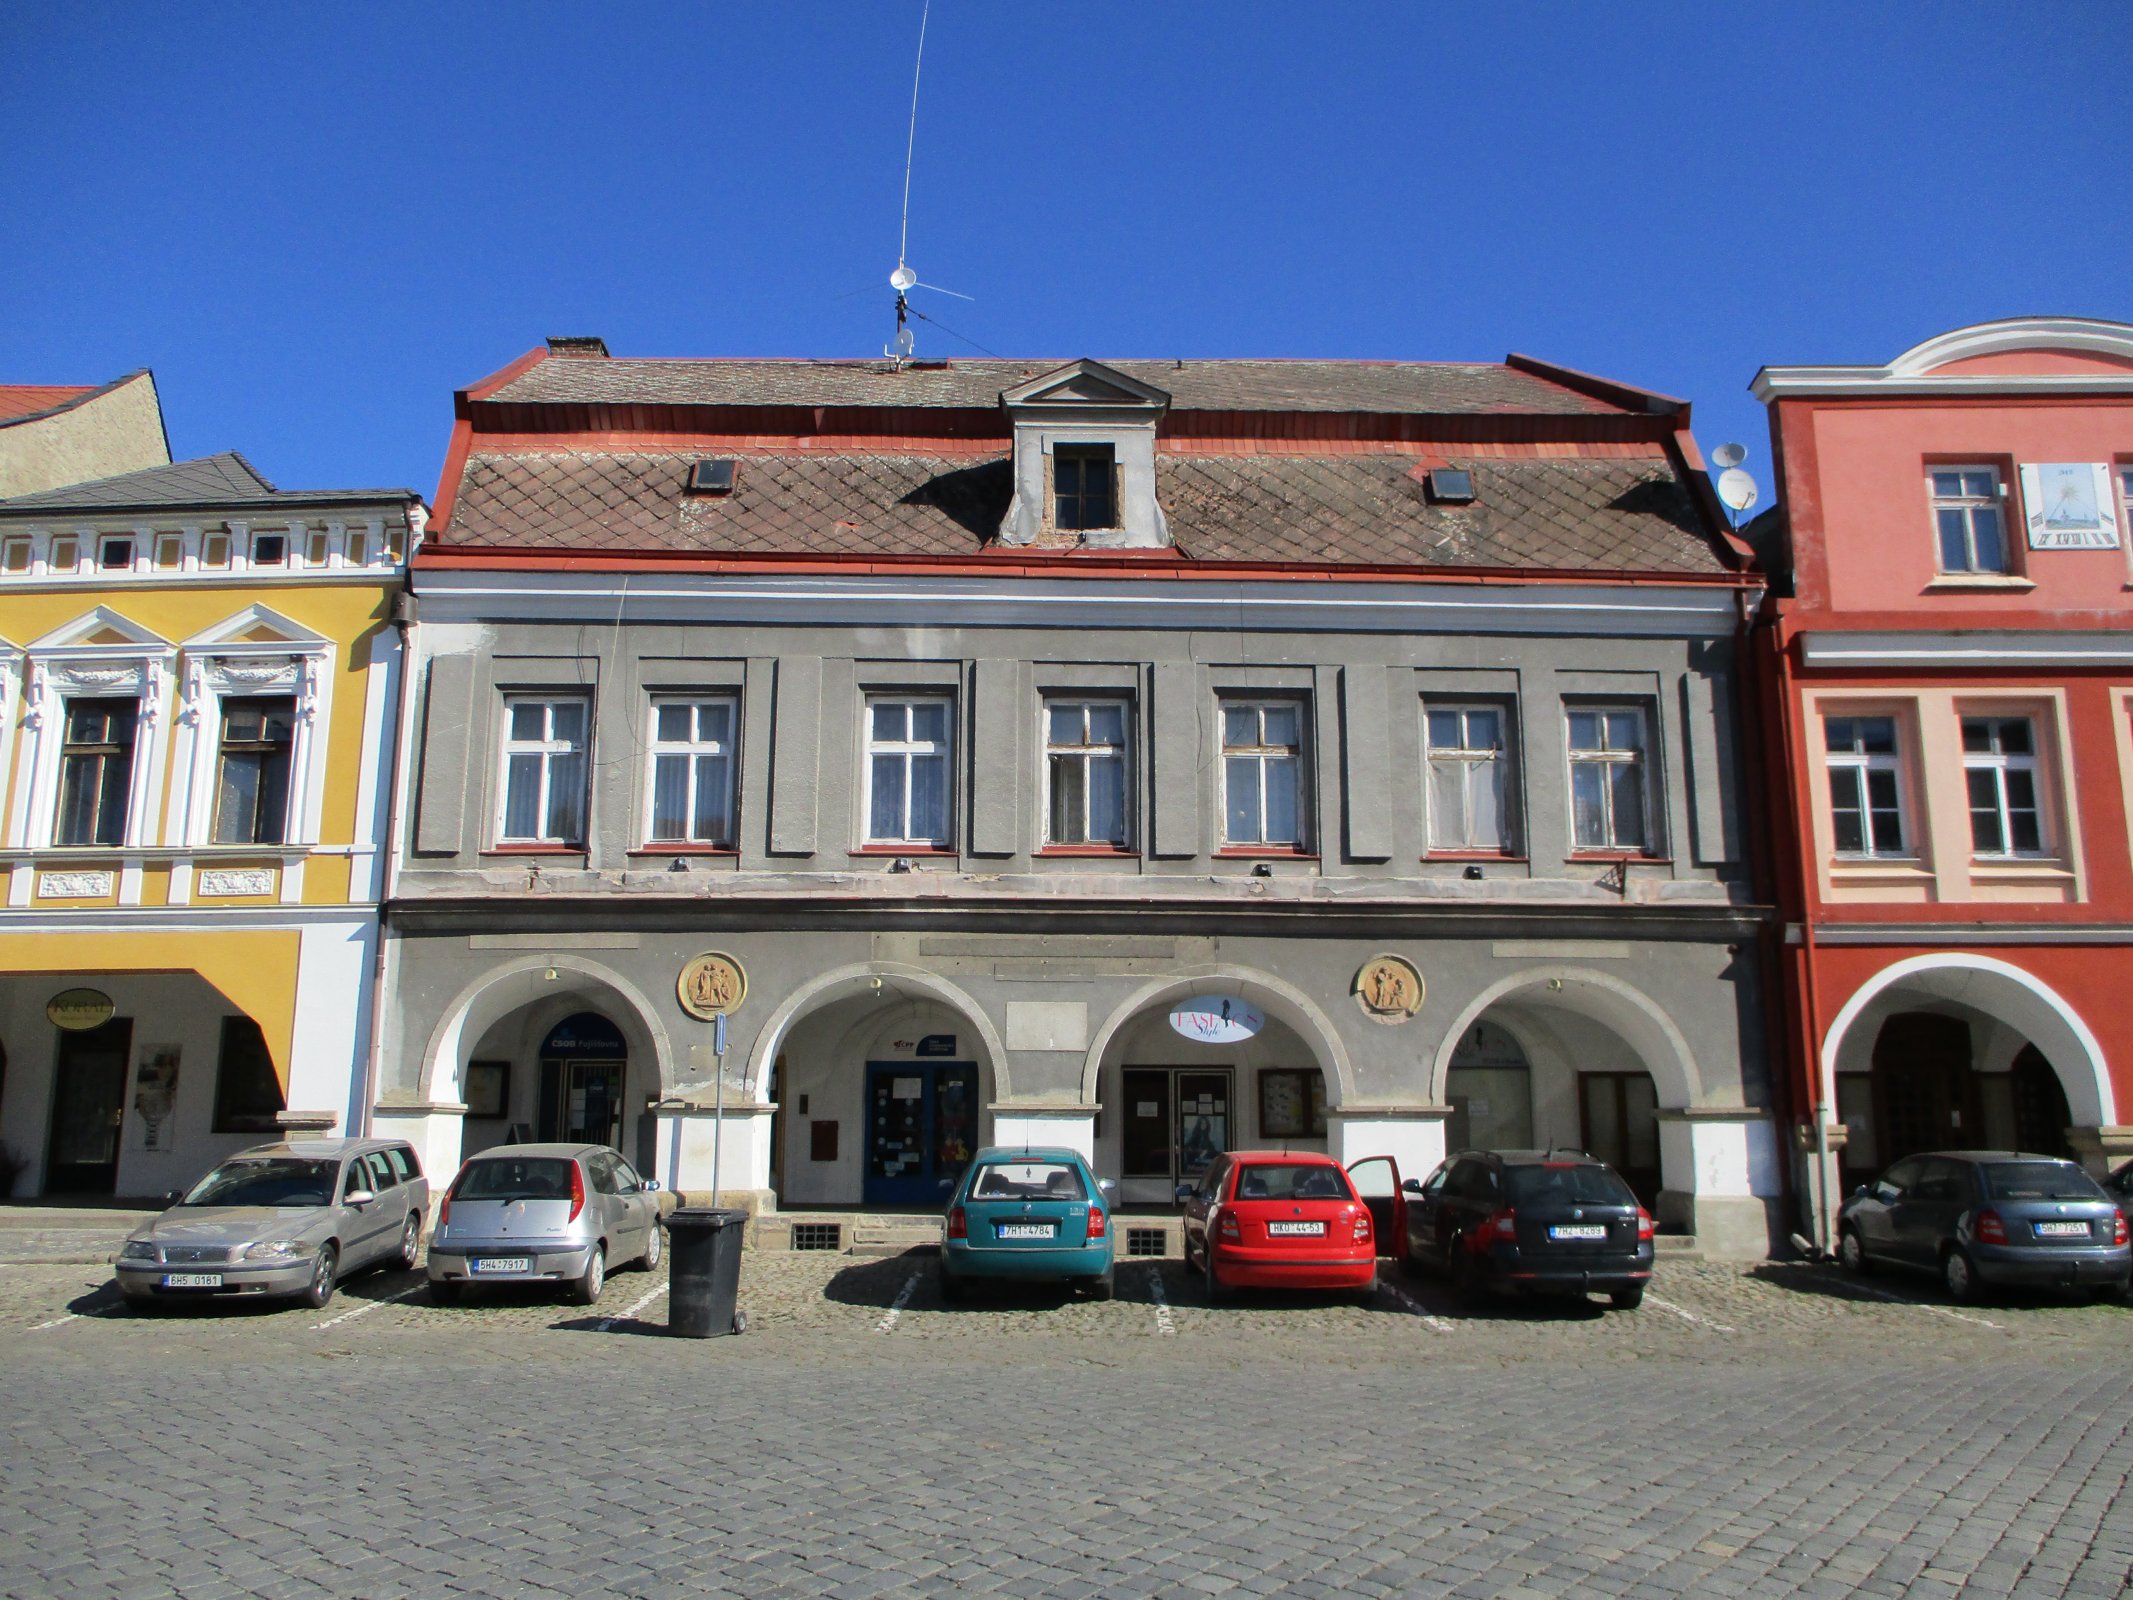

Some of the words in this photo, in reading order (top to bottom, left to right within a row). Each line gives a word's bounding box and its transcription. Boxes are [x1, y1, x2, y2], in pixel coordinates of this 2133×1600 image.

[502, 1259, 524, 1269] 7917
[171, 1275, 187, 1285] 6H5
[194, 1275, 217, 1285] 0181
